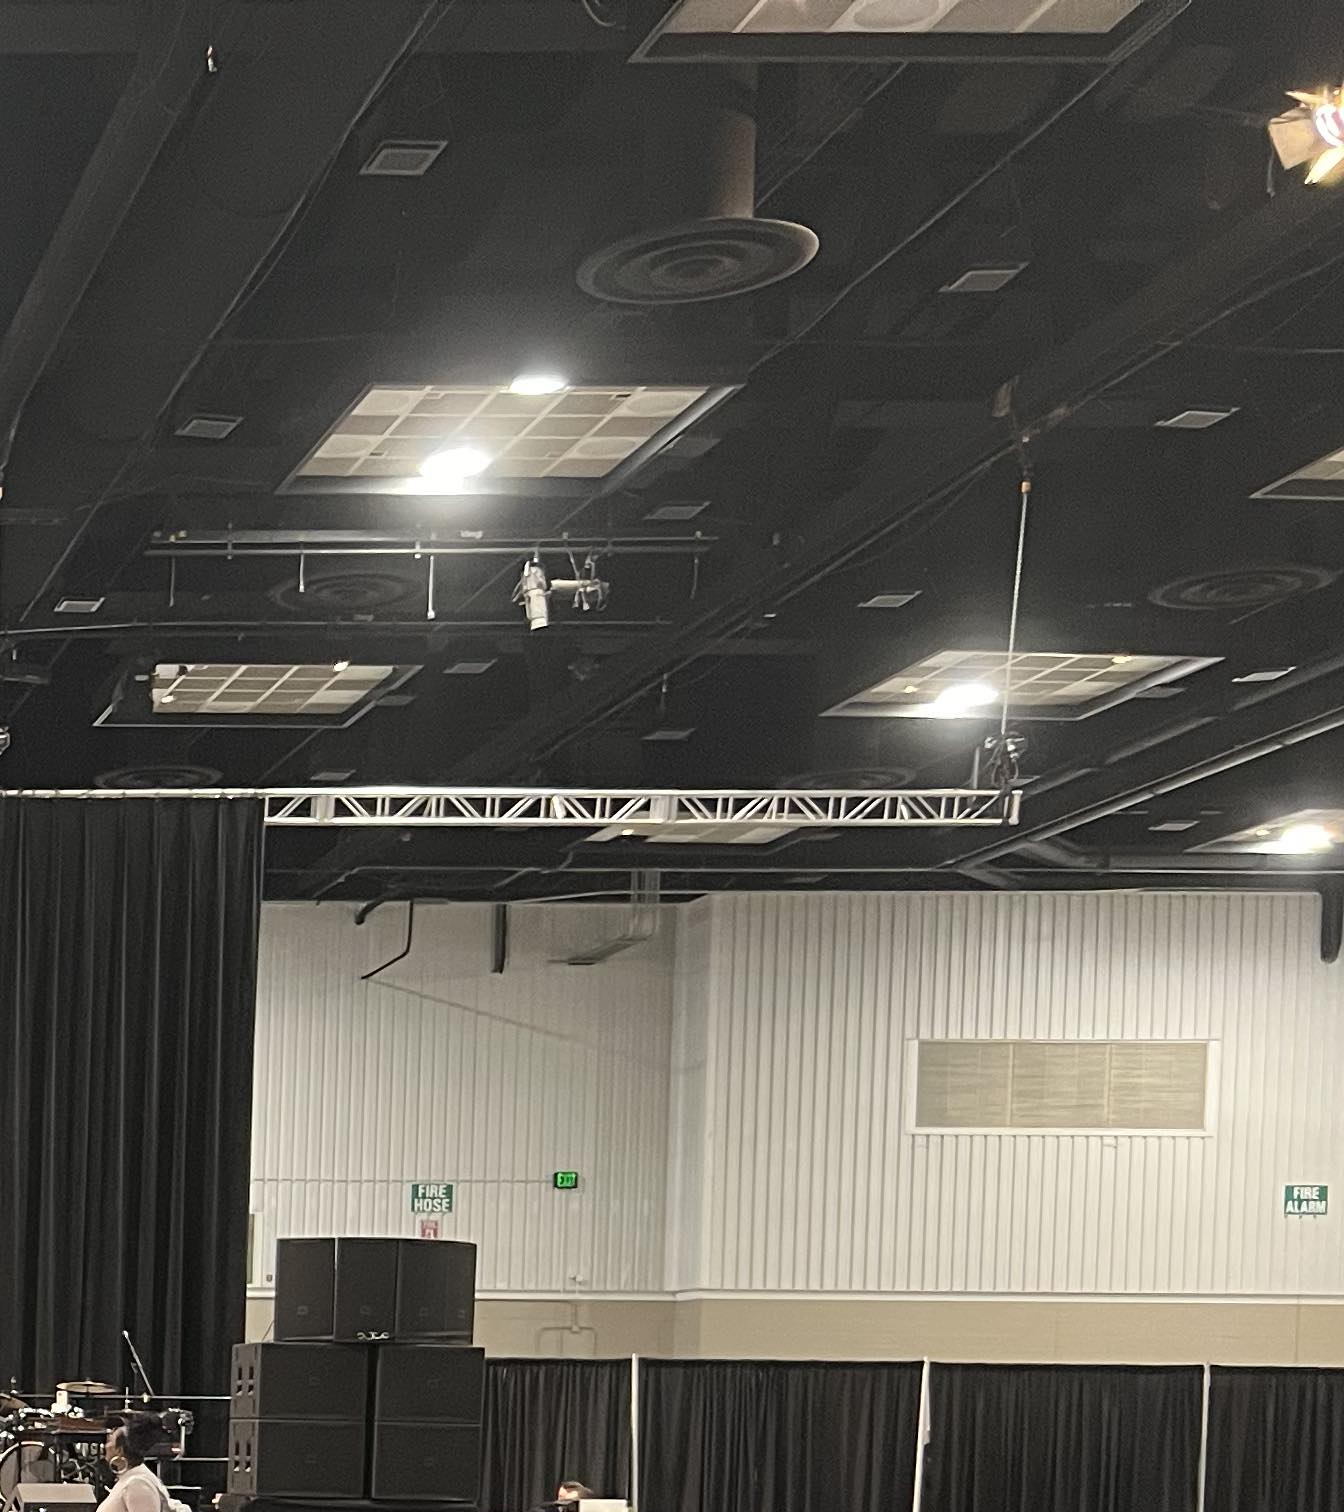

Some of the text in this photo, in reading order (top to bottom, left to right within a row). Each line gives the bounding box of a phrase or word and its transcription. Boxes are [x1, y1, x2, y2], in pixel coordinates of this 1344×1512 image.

[418, 1184, 447, 1198] FIRE
[1293, 1186, 1320, 1200] FIRE
[414, 1198, 450, 1212] HOSE
[1285, 1200, 1326, 1213] ALARM
